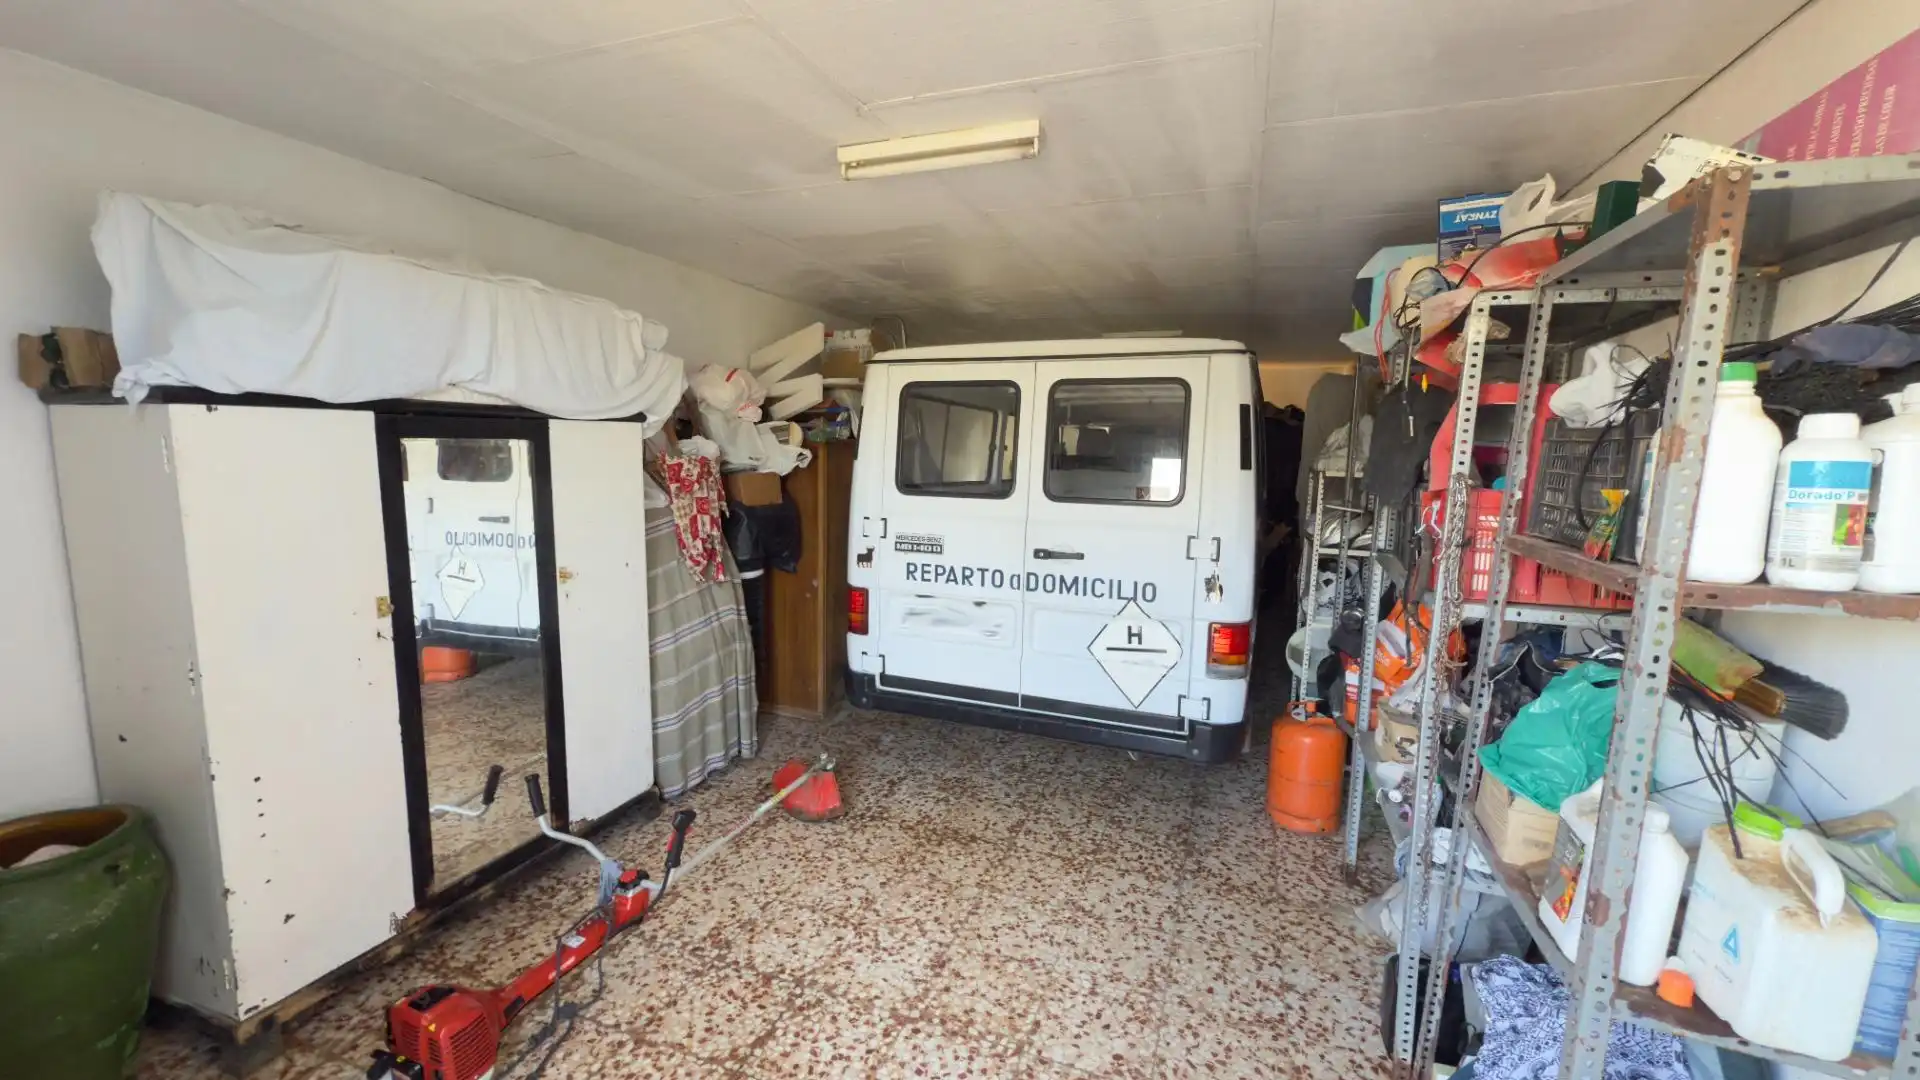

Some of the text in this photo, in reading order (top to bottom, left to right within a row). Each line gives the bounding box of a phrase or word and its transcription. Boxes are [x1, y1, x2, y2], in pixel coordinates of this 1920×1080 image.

[905, 561, 1158, 604] REPARTO a DOMICILIO
[1126, 625, 1143, 645] H
